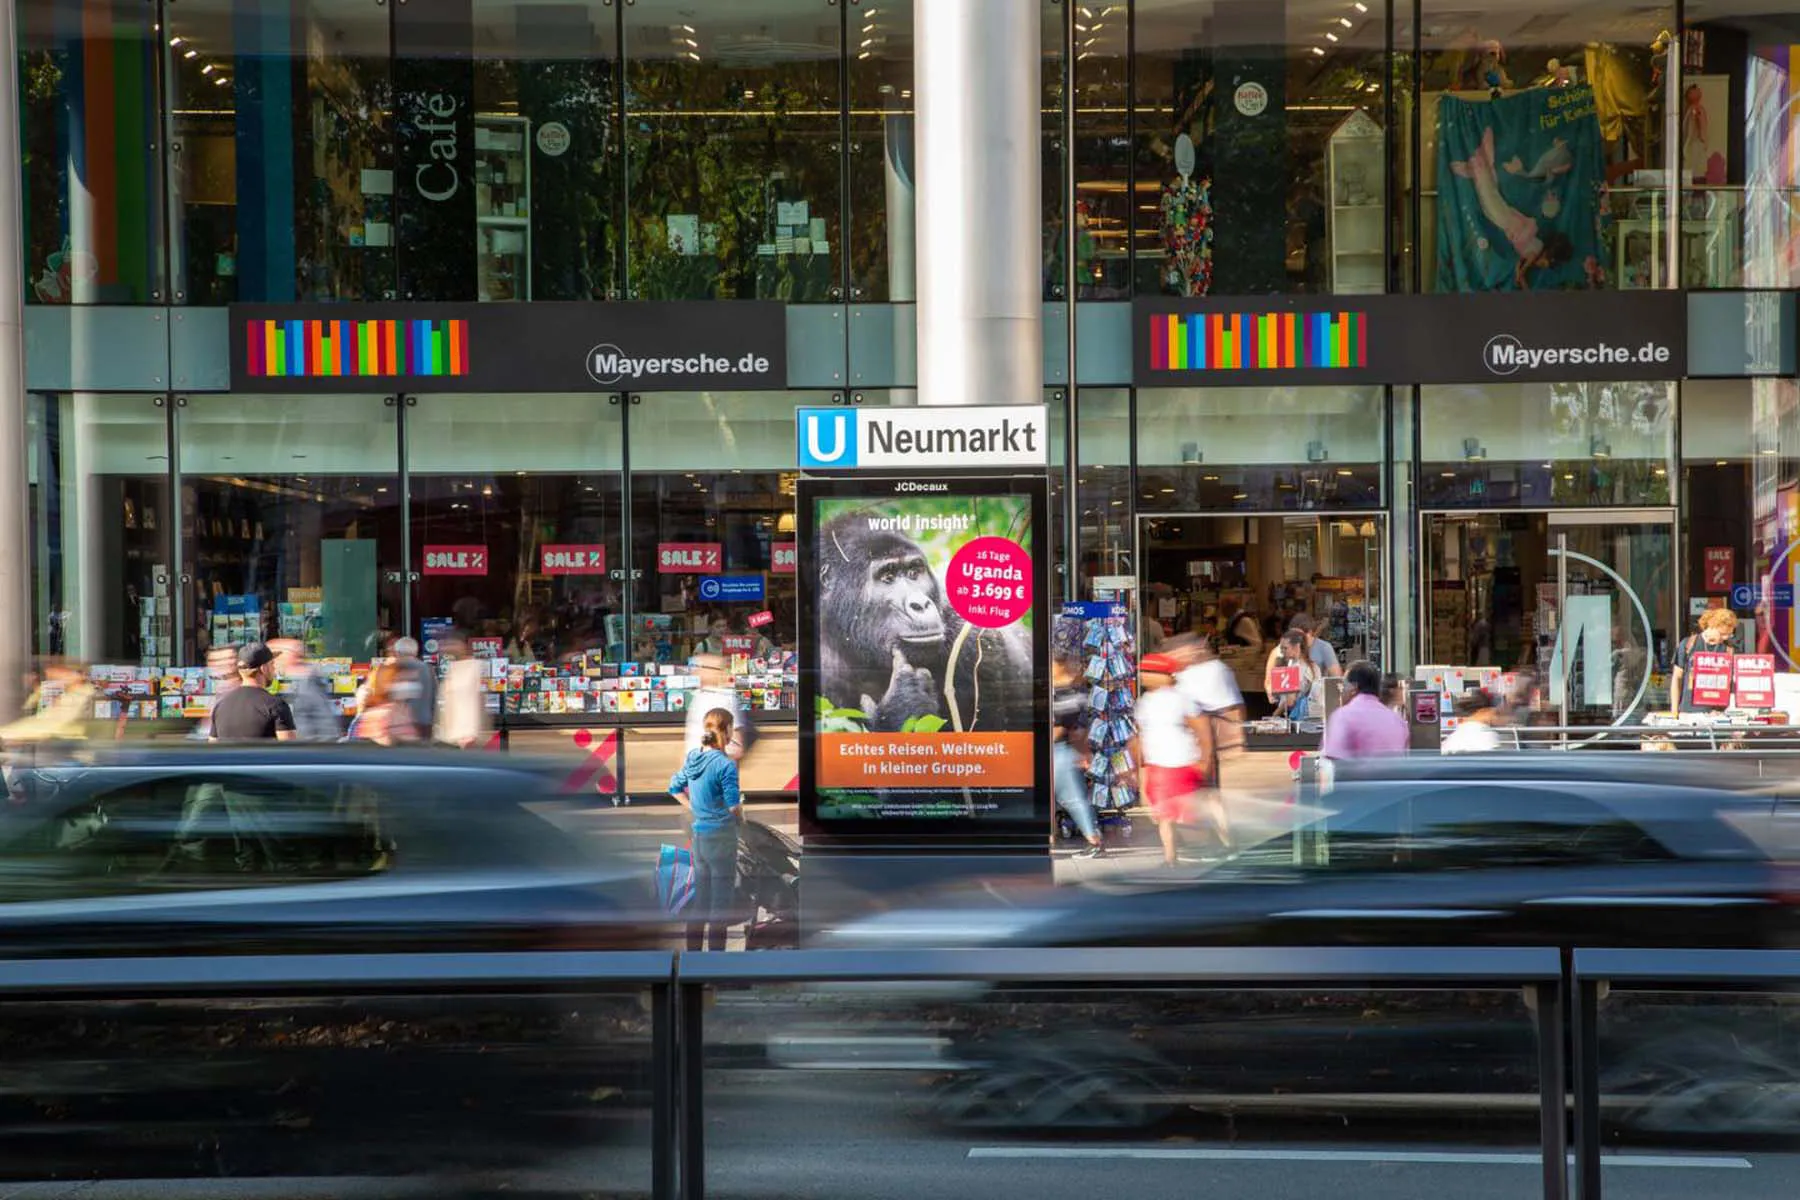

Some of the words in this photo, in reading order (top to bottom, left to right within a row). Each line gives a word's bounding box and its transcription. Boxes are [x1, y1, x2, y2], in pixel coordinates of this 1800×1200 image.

[414, 92, 458, 201] Café
[1492, 342, 1670, 368] Mayersche.de
[595, 353, 770, 378] Mayersche.de
[807, 416, 847, 463] U
[868, 419, 1037, 454] Neumarkt
[894, 482, 949, 492] JCDecaux
[868, 514, 911, 531] world
[426, 552, 468, 568] SALE
[544, 552, 586, 568] SALE
[661, 550, 703, 566] SALE
[774, 549, 795, 565] SA
[989, 551, 1011, 563] Tage
[962, 563, 1023, 581] Uganda
[956, 586, 969, 595] ab
[972, 583, 1012, 600] 3.699
[1015, 586, 1025, 599] €
[989, 606, 1011, 619] Flug
[839, 743, 884, 756] Echtes
[888, 743, 938, 756] Reisen.
[941, 743, 1009, 756] Weltweit.
[863, 762, 877, 774] In
[880, 762, 928, 774] kleiner
[932, 762, 986, 776] Gruppe.
